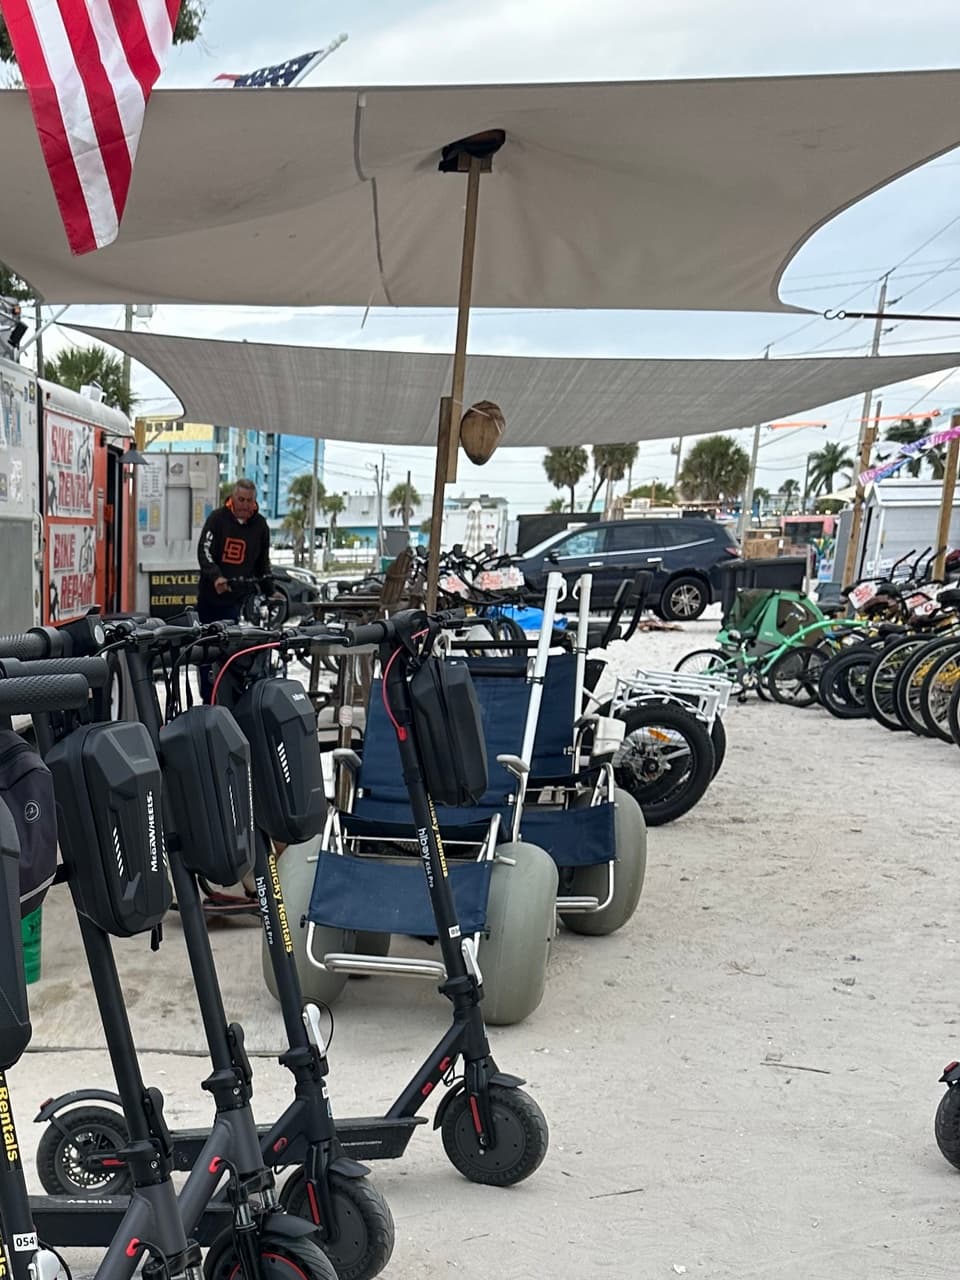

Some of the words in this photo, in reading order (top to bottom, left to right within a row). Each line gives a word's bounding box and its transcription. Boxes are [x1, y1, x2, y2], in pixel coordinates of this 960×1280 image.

[58, 471, 91, 509] RENTAL
[54, 533, 76, 569] BIKE
[151, 595, 184, 606] ELECTRIC
[255, 876, 270, 914] hiboy
[16, 1236, 36, 1248] 054
